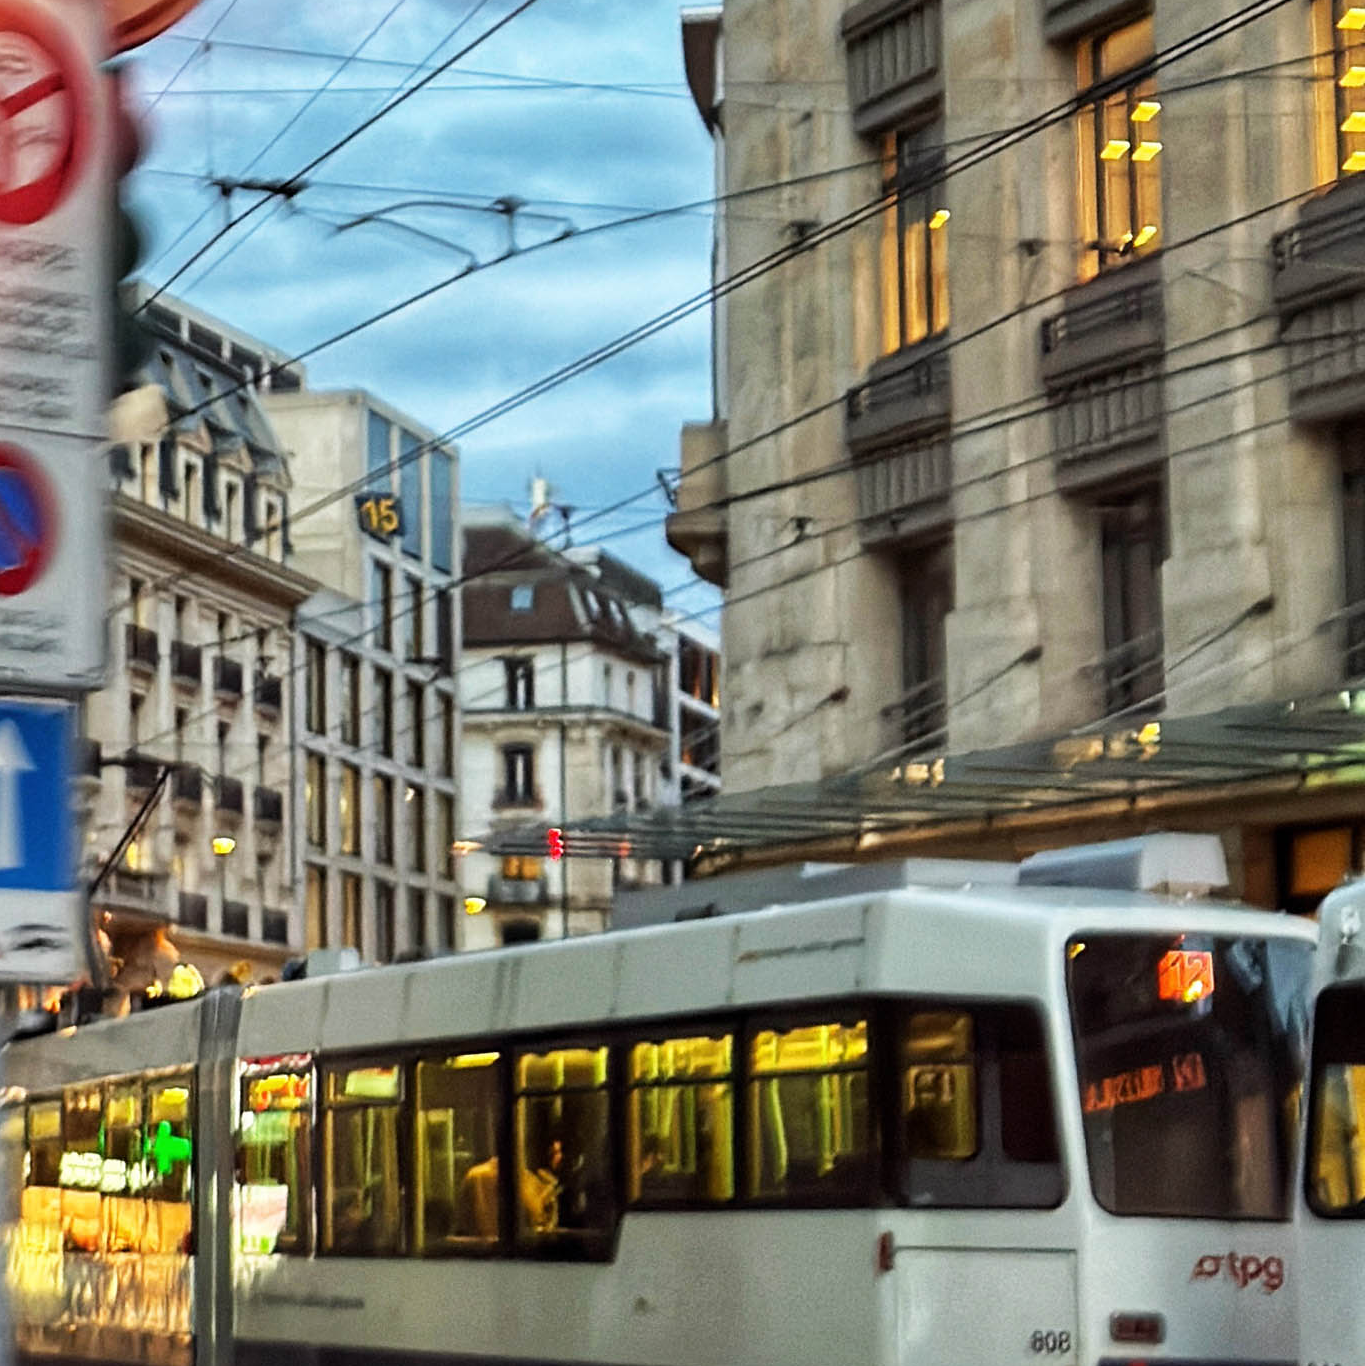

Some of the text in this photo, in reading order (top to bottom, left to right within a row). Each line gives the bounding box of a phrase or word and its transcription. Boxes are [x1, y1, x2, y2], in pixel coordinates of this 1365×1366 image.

[362, 497, 399, 535] 15
[1168, 953, 1208, 995] 12
[1229, 1250, 1285, 1295] tpg
